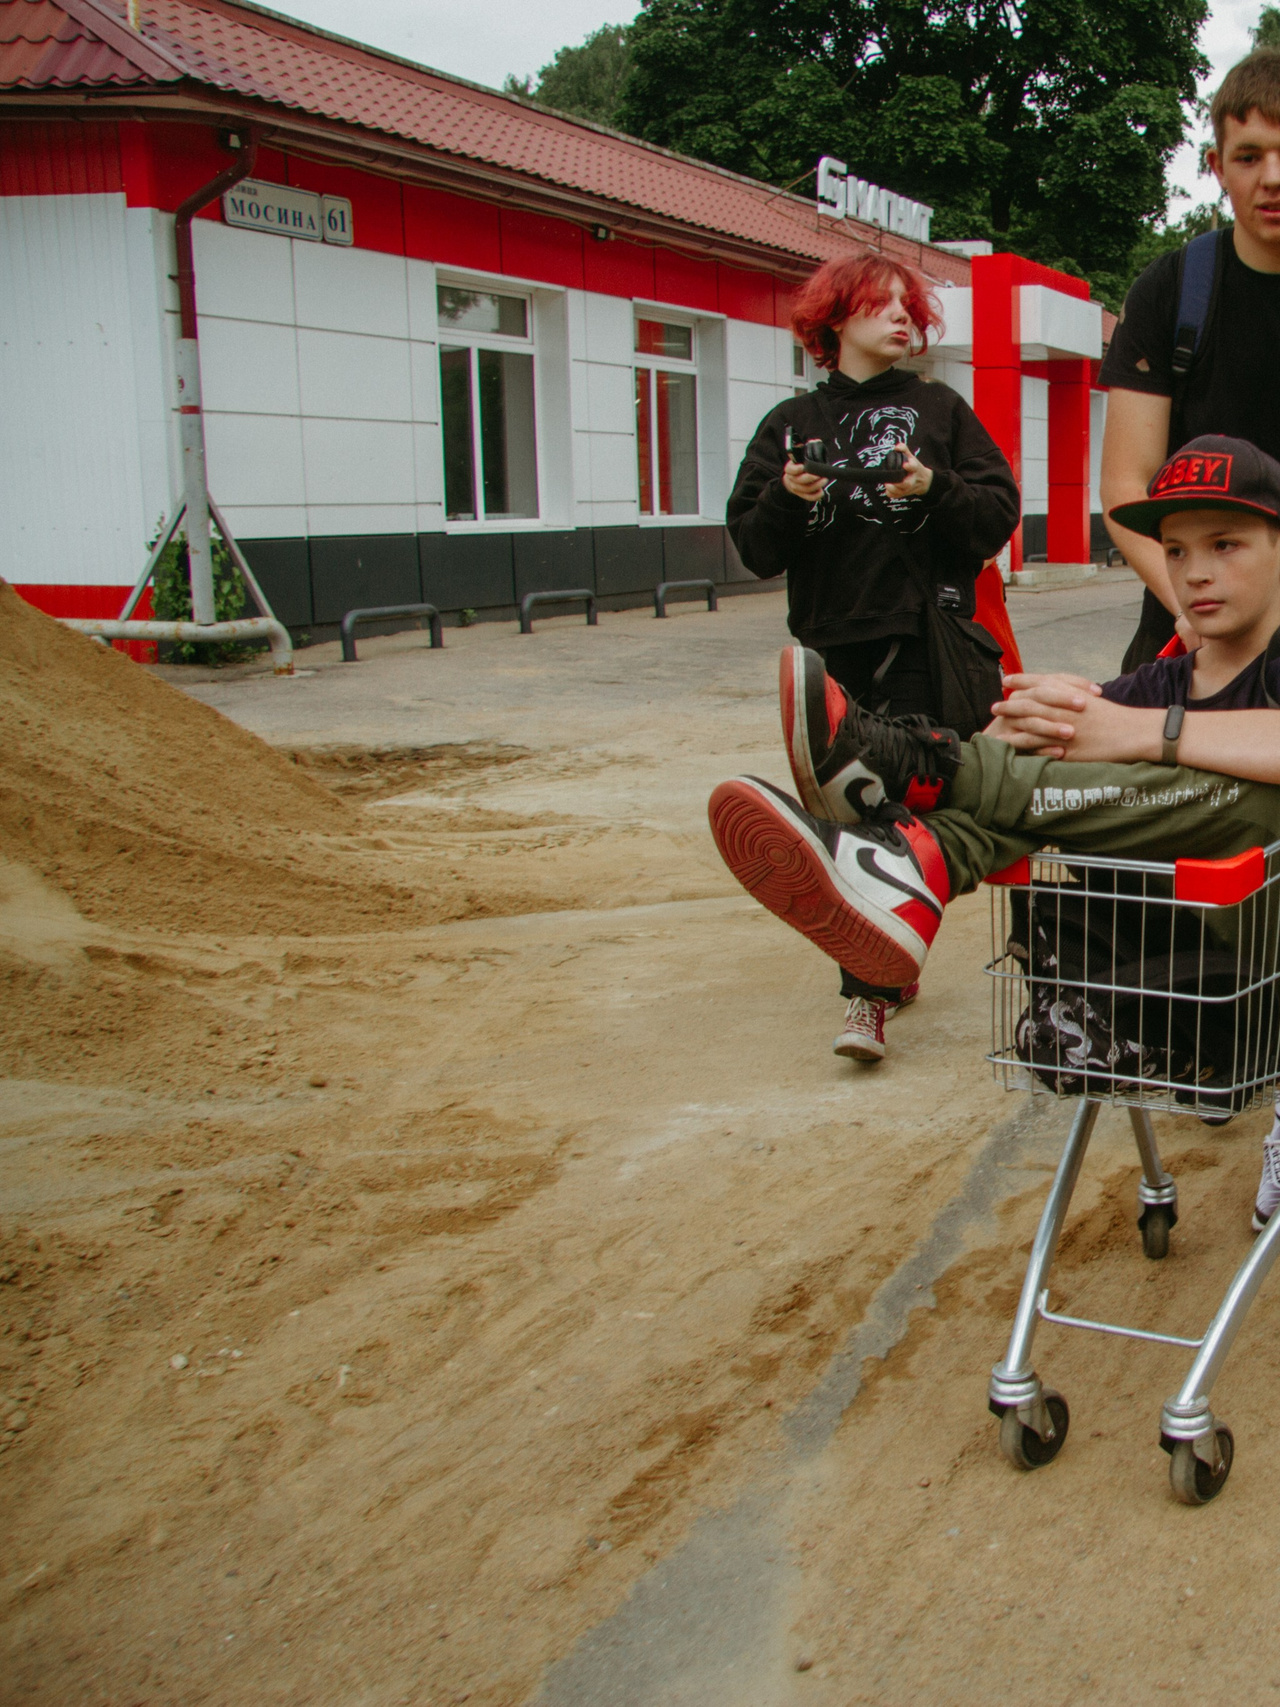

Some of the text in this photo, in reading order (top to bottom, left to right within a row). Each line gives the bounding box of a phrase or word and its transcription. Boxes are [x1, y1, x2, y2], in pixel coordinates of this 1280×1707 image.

[230, 184, 258, 196] лица
[230, 196, 317, 231] МОСИНА
[327, 208, 347, 233] 61
[1157, 458, 1223, 490] OBEY
